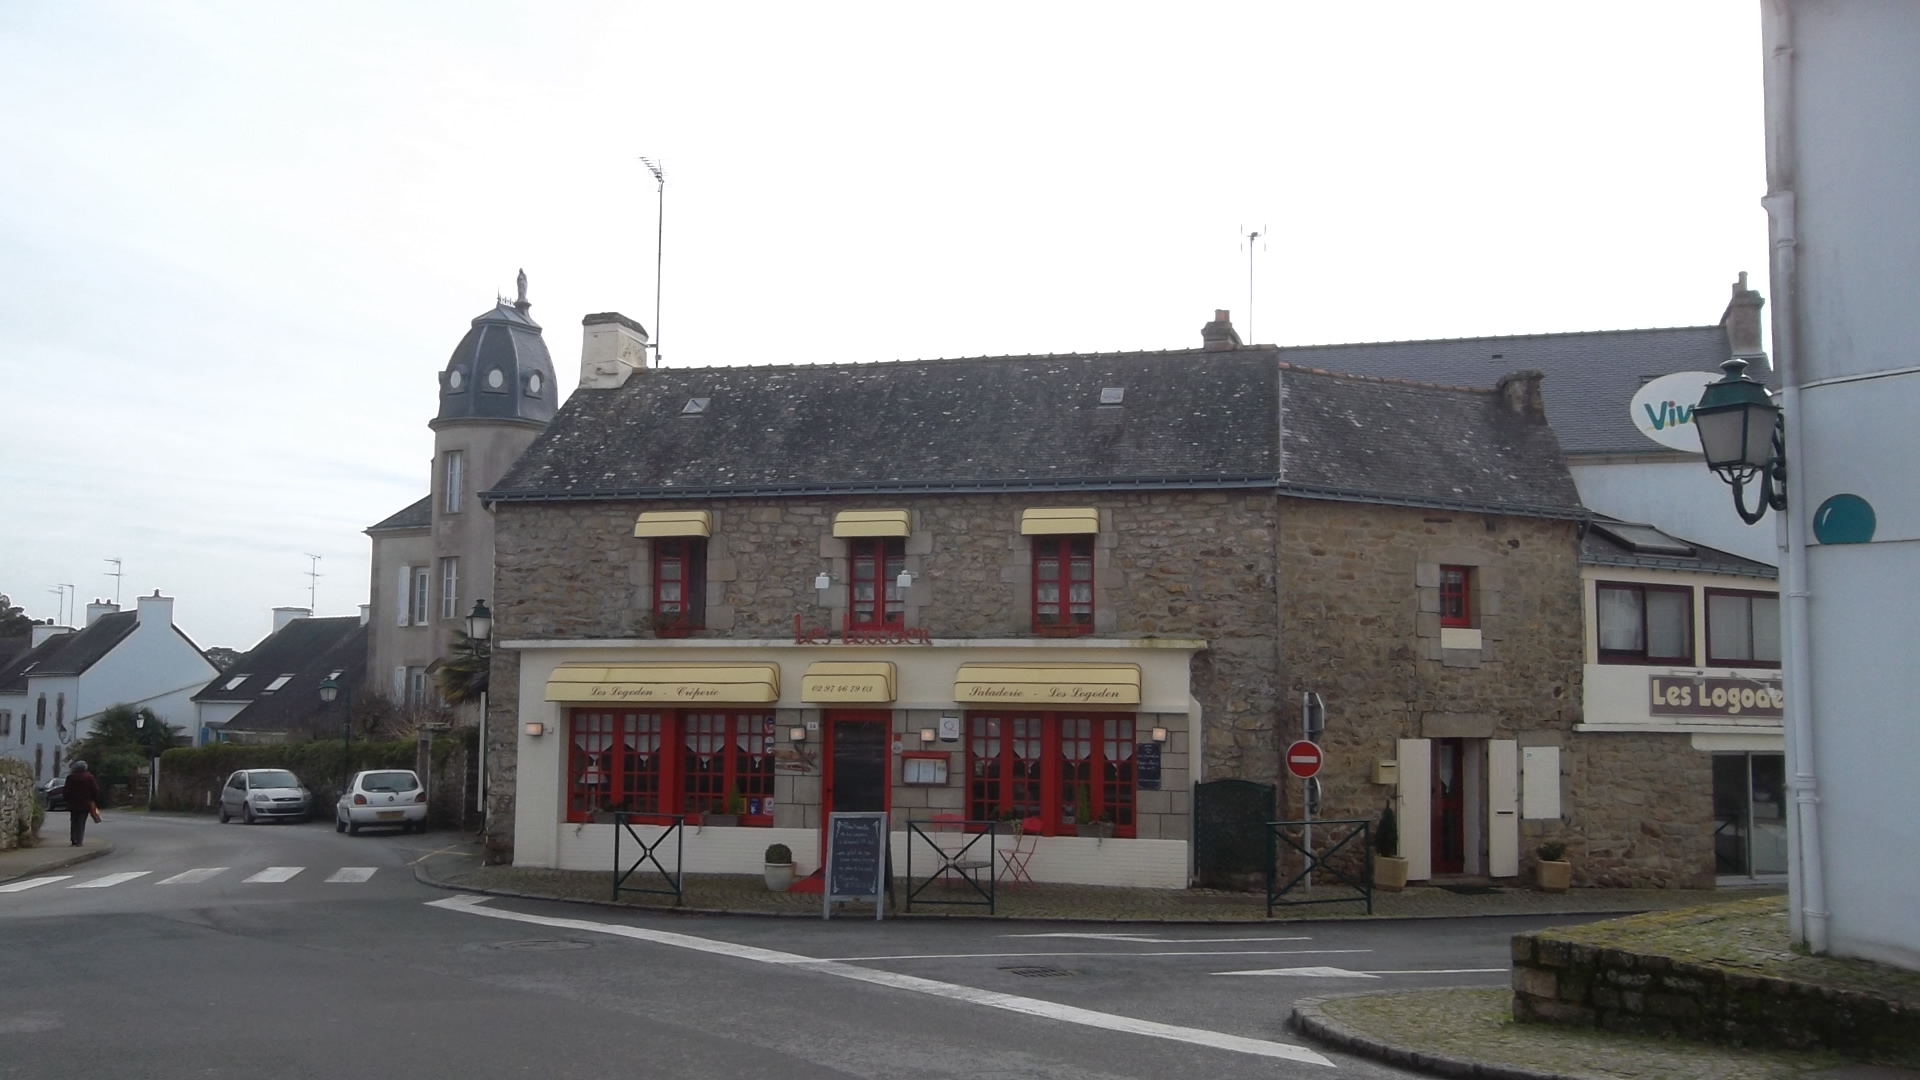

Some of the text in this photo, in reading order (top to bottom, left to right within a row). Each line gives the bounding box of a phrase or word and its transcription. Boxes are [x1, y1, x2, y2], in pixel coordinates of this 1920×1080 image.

[590, 687, 606, 696] Les
[611, 687, 653, 699] Logoden
[676, 687, 720, 700] Crêperie
[969, 687, 1023, 697] Saladerie
[1048, 688, 1067, 698] Les
[1071, 688, 1120, 701] Logoden
[1652, 679, 1692, 707] Les
